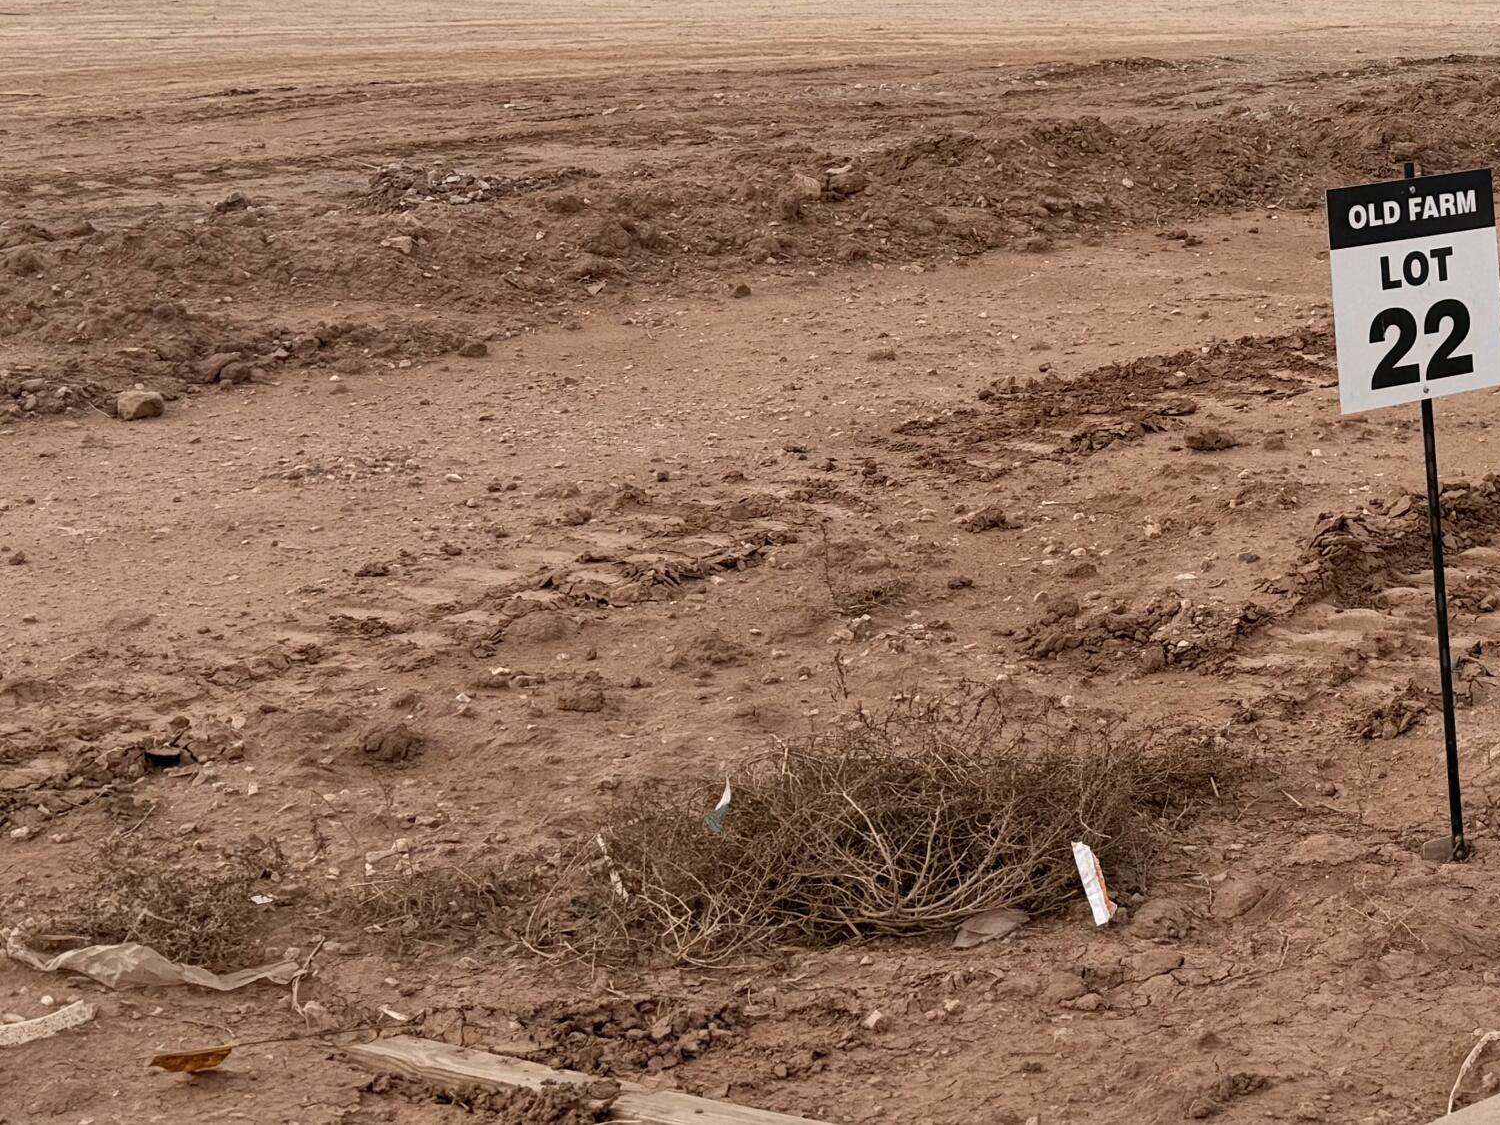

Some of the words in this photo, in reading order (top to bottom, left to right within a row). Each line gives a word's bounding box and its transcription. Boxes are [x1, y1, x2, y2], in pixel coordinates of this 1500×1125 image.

[1349, 201, 1400, 229] OLD
[1408, 189, 1477, 221] FARM
[1380, 246, 1453, 290] LOT
[1369, 299, 1474, 391] 22
